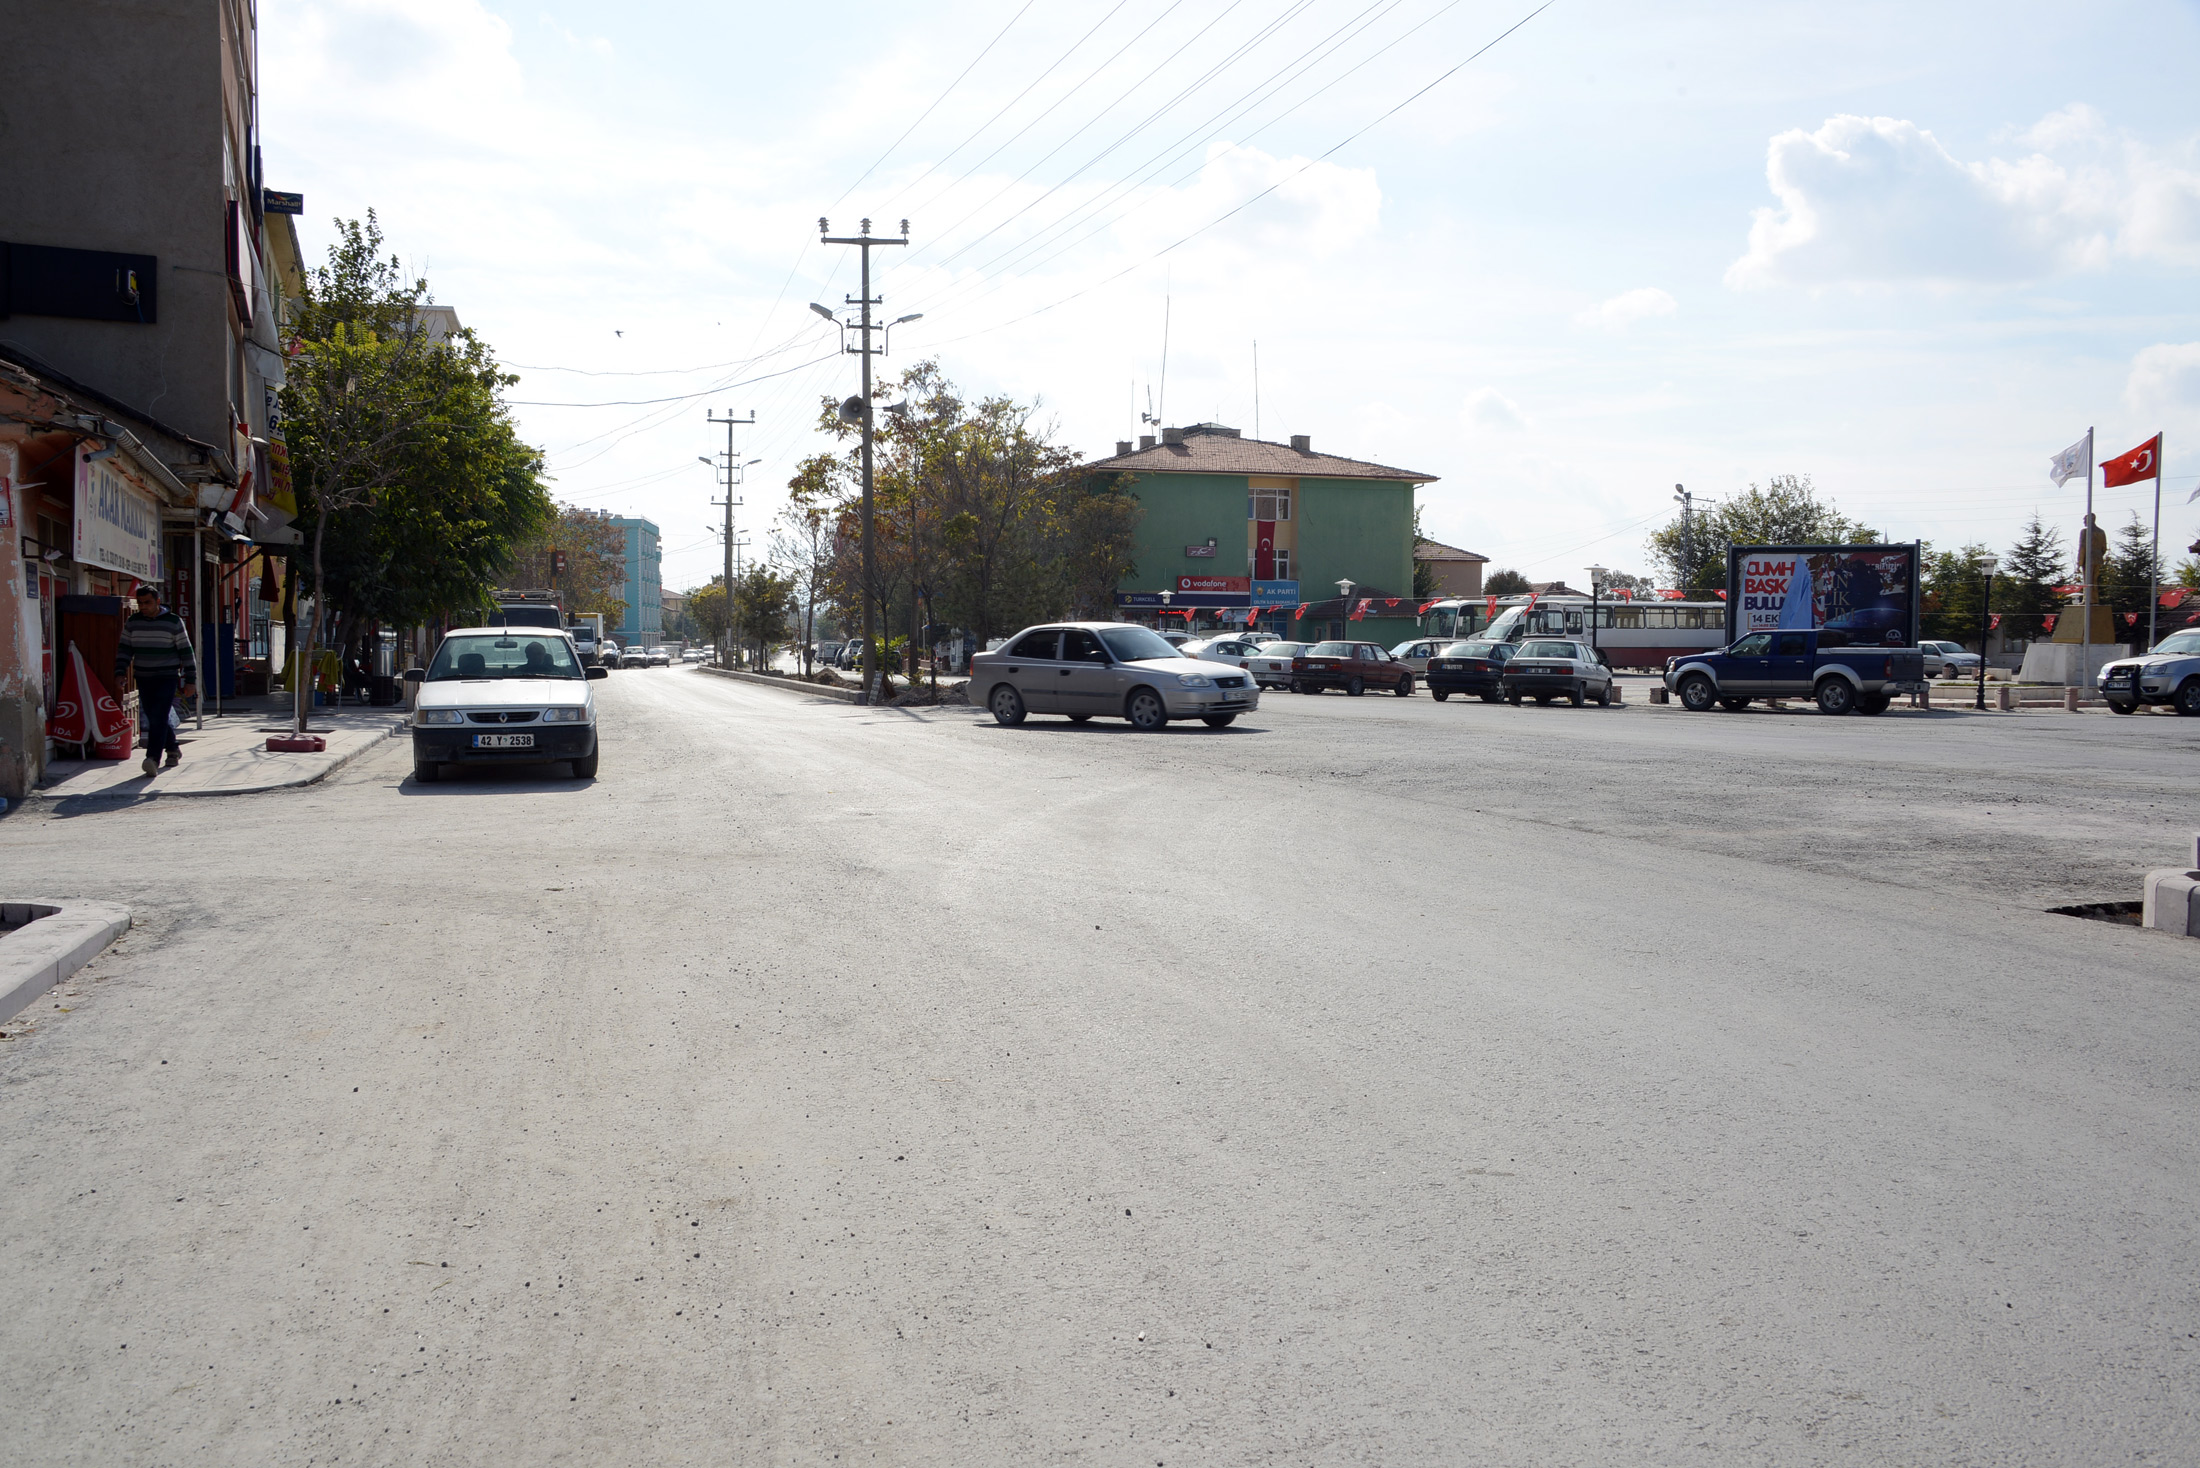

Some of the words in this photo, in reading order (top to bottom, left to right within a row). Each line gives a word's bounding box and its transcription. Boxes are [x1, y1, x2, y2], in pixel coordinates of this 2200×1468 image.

[267, 198, 298, 206] Marshall
[98, 470, 119, 527] ACAR
[1745, 578, 1788, 595] BAŞK
[1744, 596, 1785, 610] BULU
[1752, 614, 1763, 622] 14
[480, 736, 492, 746] 42
[496, 736, 502, 746] Y
[510, 736, 532, 746] 2538
